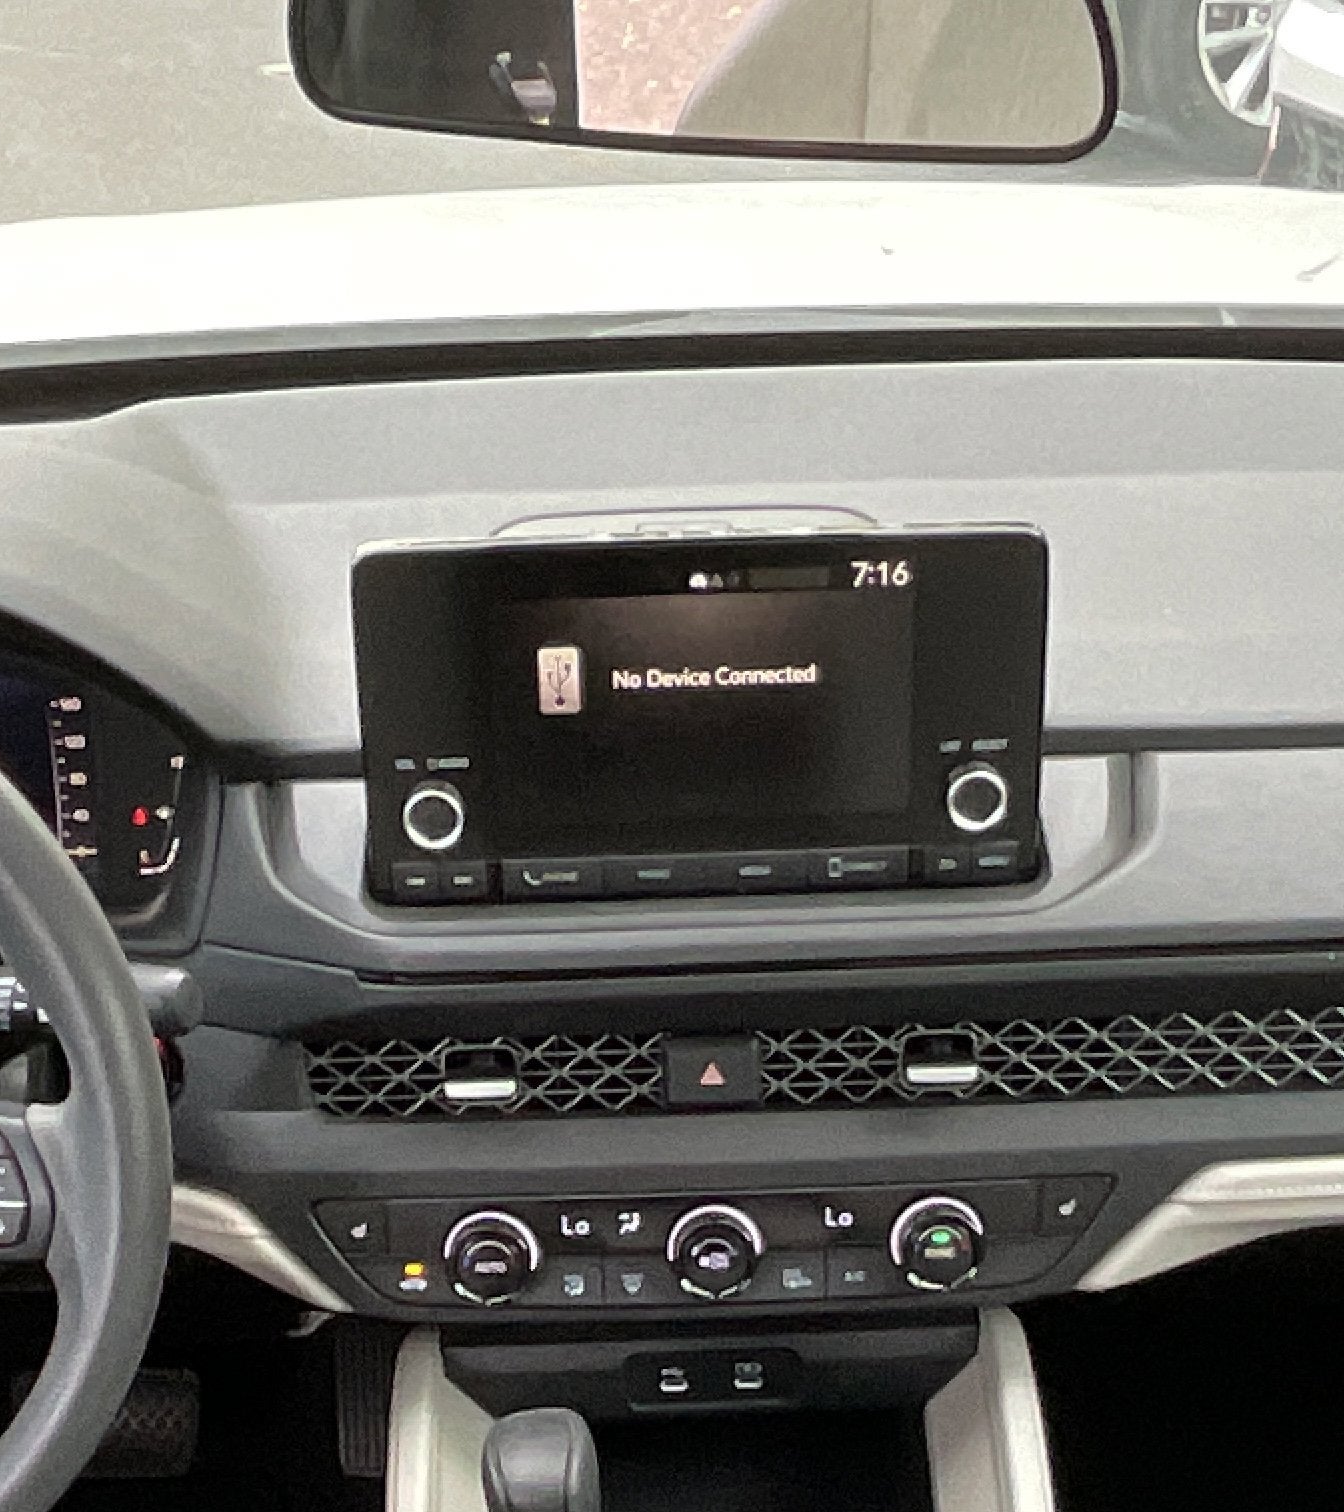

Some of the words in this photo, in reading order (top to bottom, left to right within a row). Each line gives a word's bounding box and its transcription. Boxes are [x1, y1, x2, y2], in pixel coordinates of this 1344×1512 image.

[850, 560, 912, 588] 7:16
[610, 669, 643, 690] No
[646, 667, 712, 688] Device
[714, 662, 818, 686] Connected
[560, 1214, 591, 1237] Lo
[824, 1206, 855, 1228] Lo
